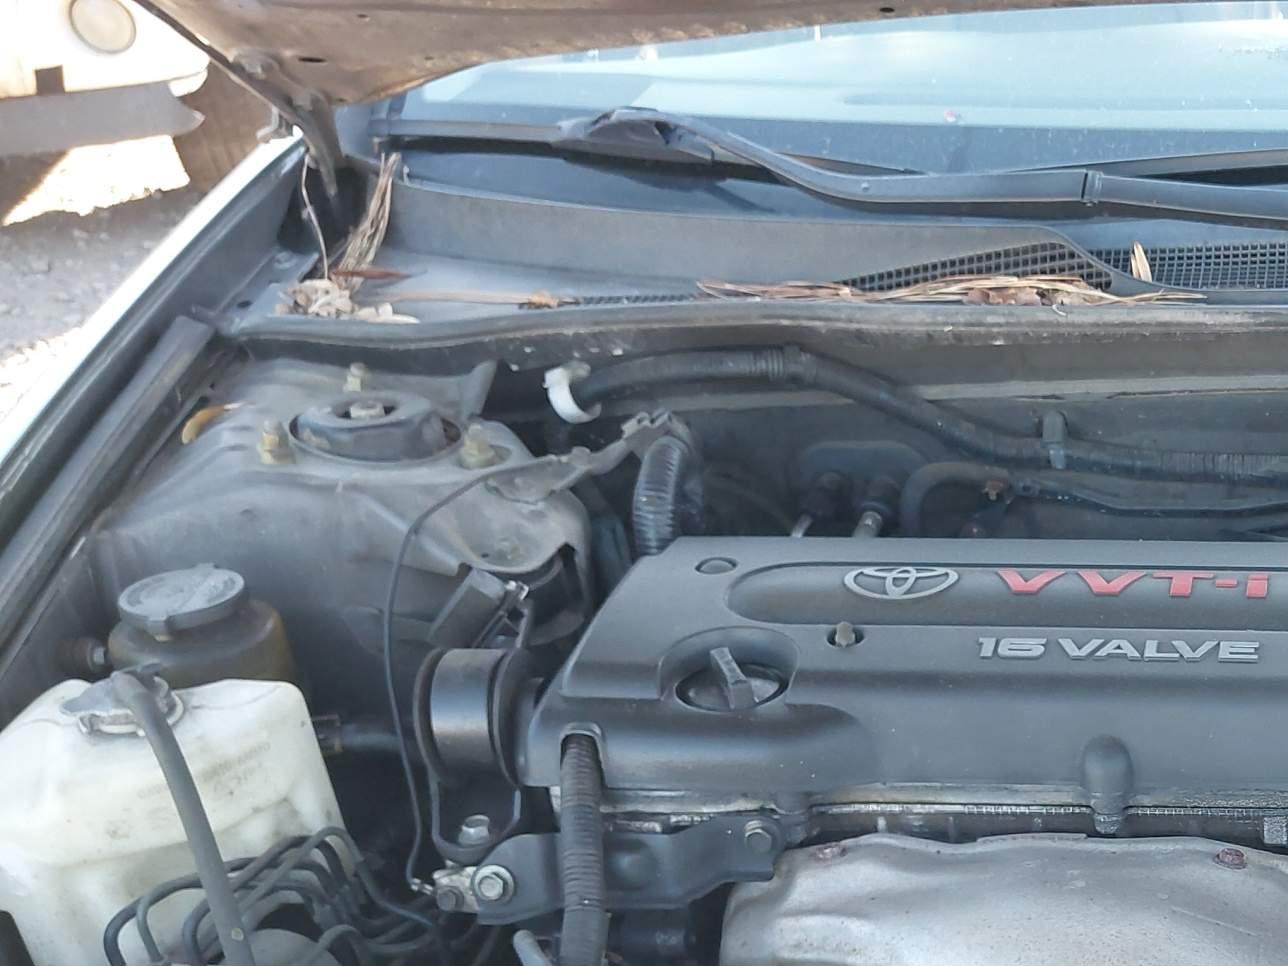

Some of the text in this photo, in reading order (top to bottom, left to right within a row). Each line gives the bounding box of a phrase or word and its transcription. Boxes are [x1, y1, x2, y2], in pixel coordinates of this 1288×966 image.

[996, 569, 1271, 599] VVT-i
[978, 636, 1259, 663] 16 VALVE
